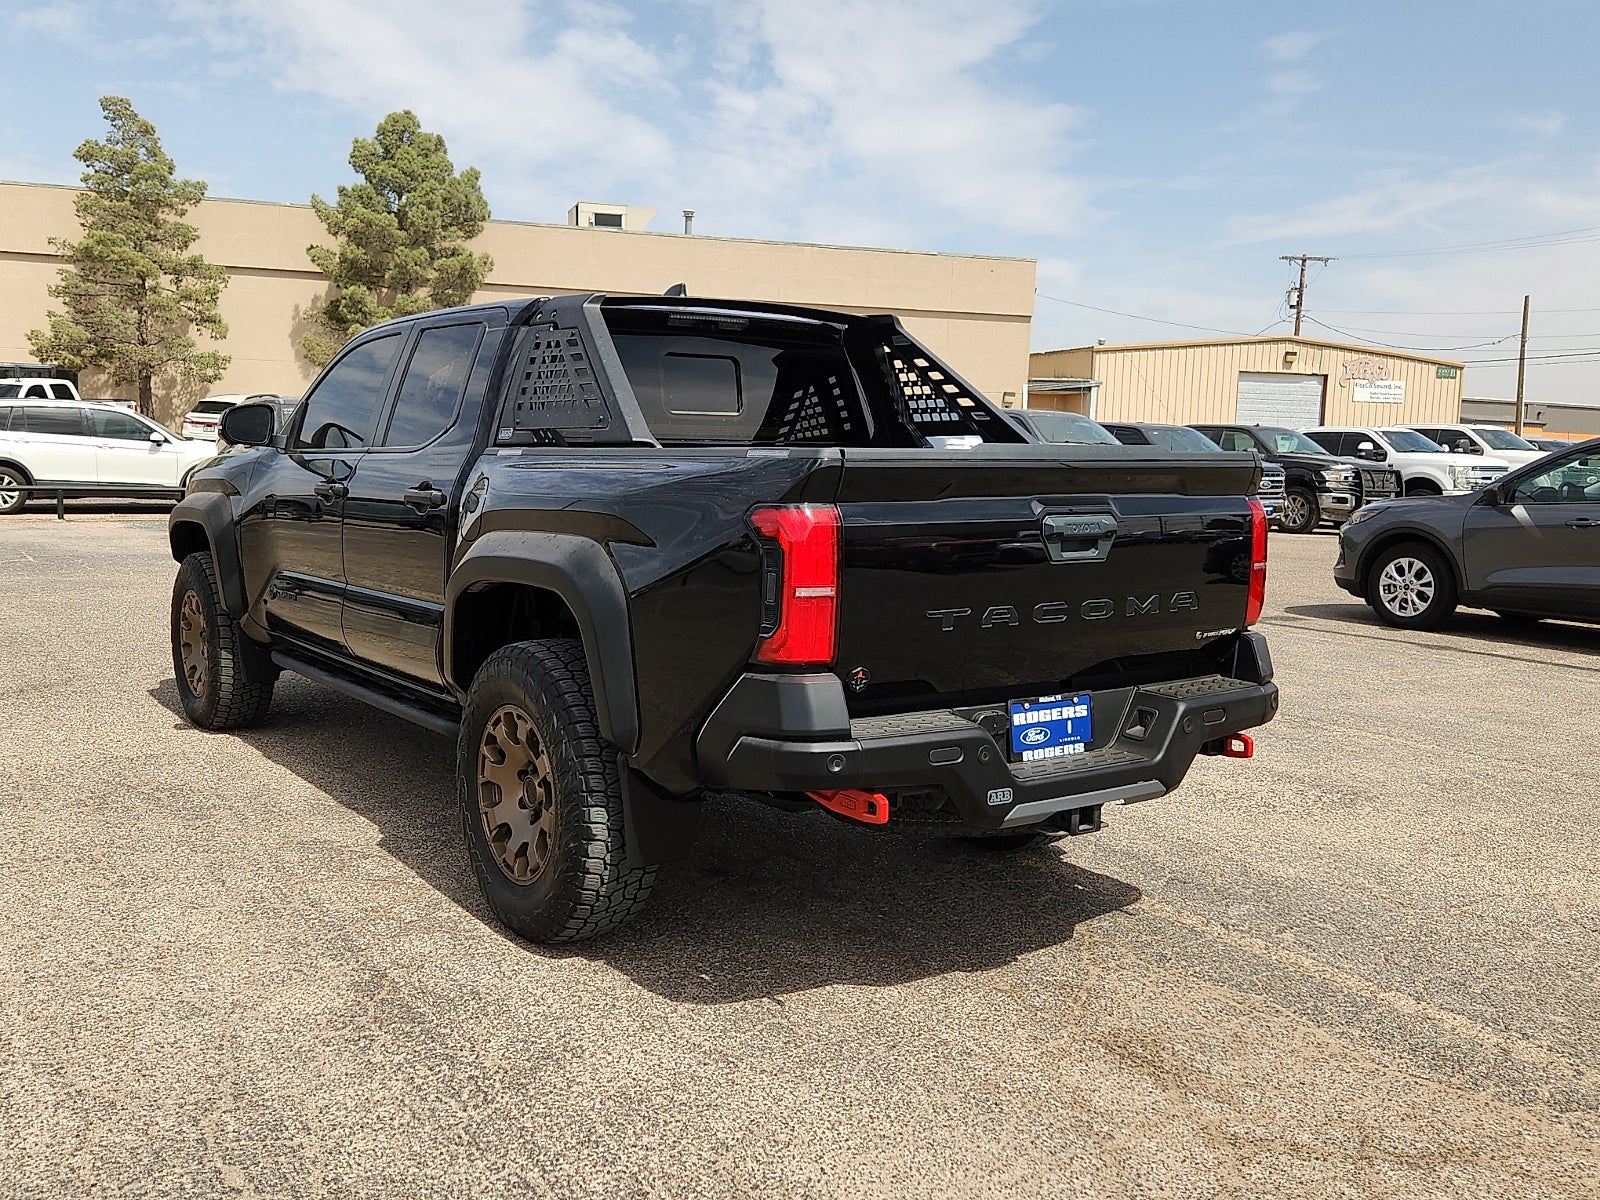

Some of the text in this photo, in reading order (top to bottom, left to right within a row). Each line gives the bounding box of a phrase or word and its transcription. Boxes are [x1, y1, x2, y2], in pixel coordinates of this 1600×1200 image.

[1065, 522, 1102, 534] TOYOTA
[925, 591, 1199, 631] TACOMA
[1013, 704, 1088, 726] ROGERS
[1025, 728, 1047, 742] Ford
[1022, 742, 1085, 762] ROGERS
[989, 790, 1012, 803] ARB
